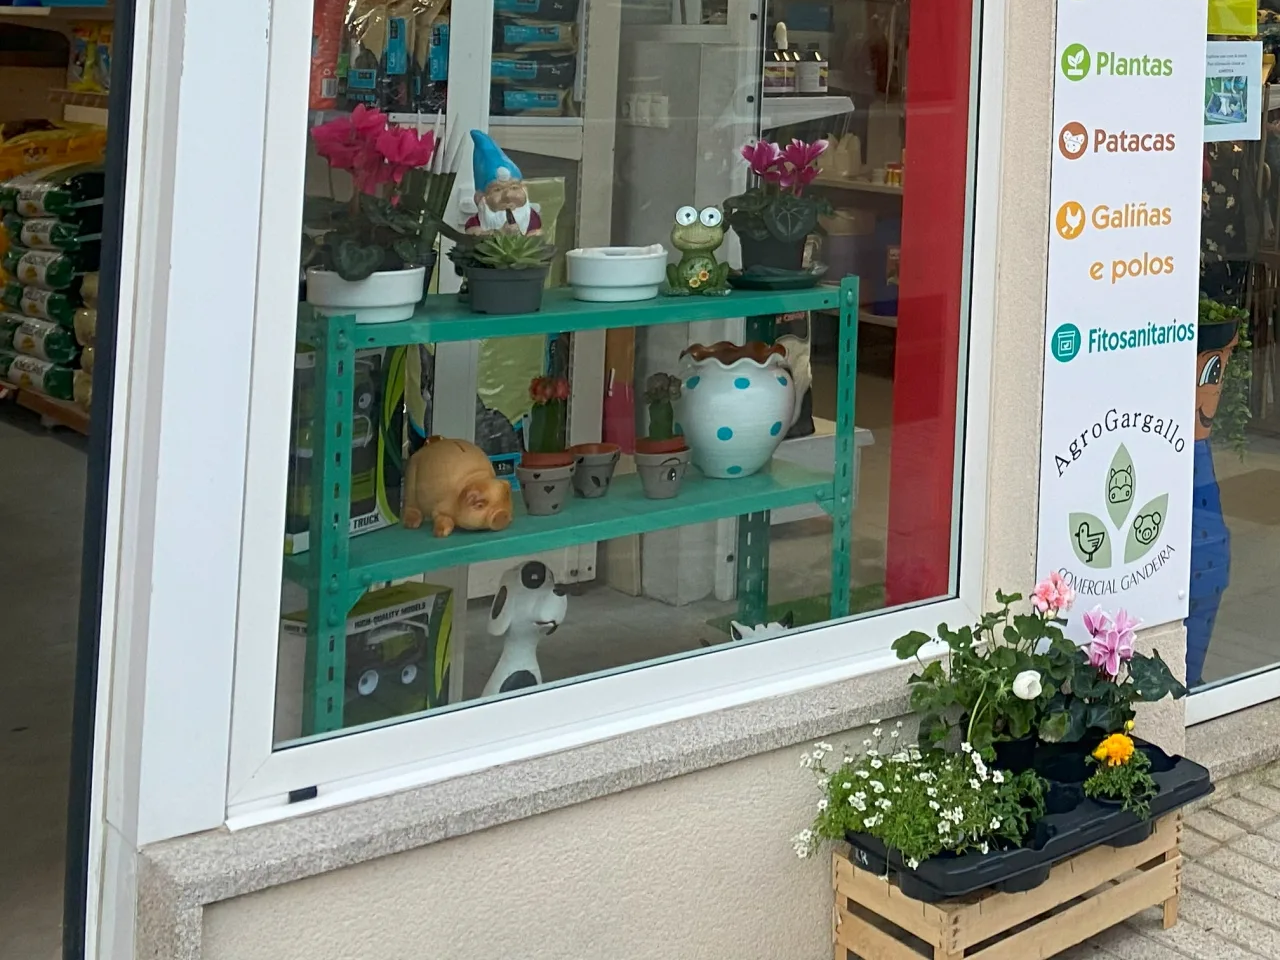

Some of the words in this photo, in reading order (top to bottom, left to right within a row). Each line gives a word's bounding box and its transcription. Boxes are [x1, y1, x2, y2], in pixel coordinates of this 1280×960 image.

[1096, 51, 1173, 77] Plantas
[1093, 128, 1176, 154] Patacas
[1091, 202, 1172, 230] Galiñas
[1089, 261, 1105, 281] e
[1111, 251, 1175, 285] polos
[1088, 318, 1195, 354] Fitosanitarios
[1053, 408, 1186, 478] AgroGargallo
[353, 513, 380, 529] TRUCK
[1120, 544, 1176, 591] GANDEIRA
